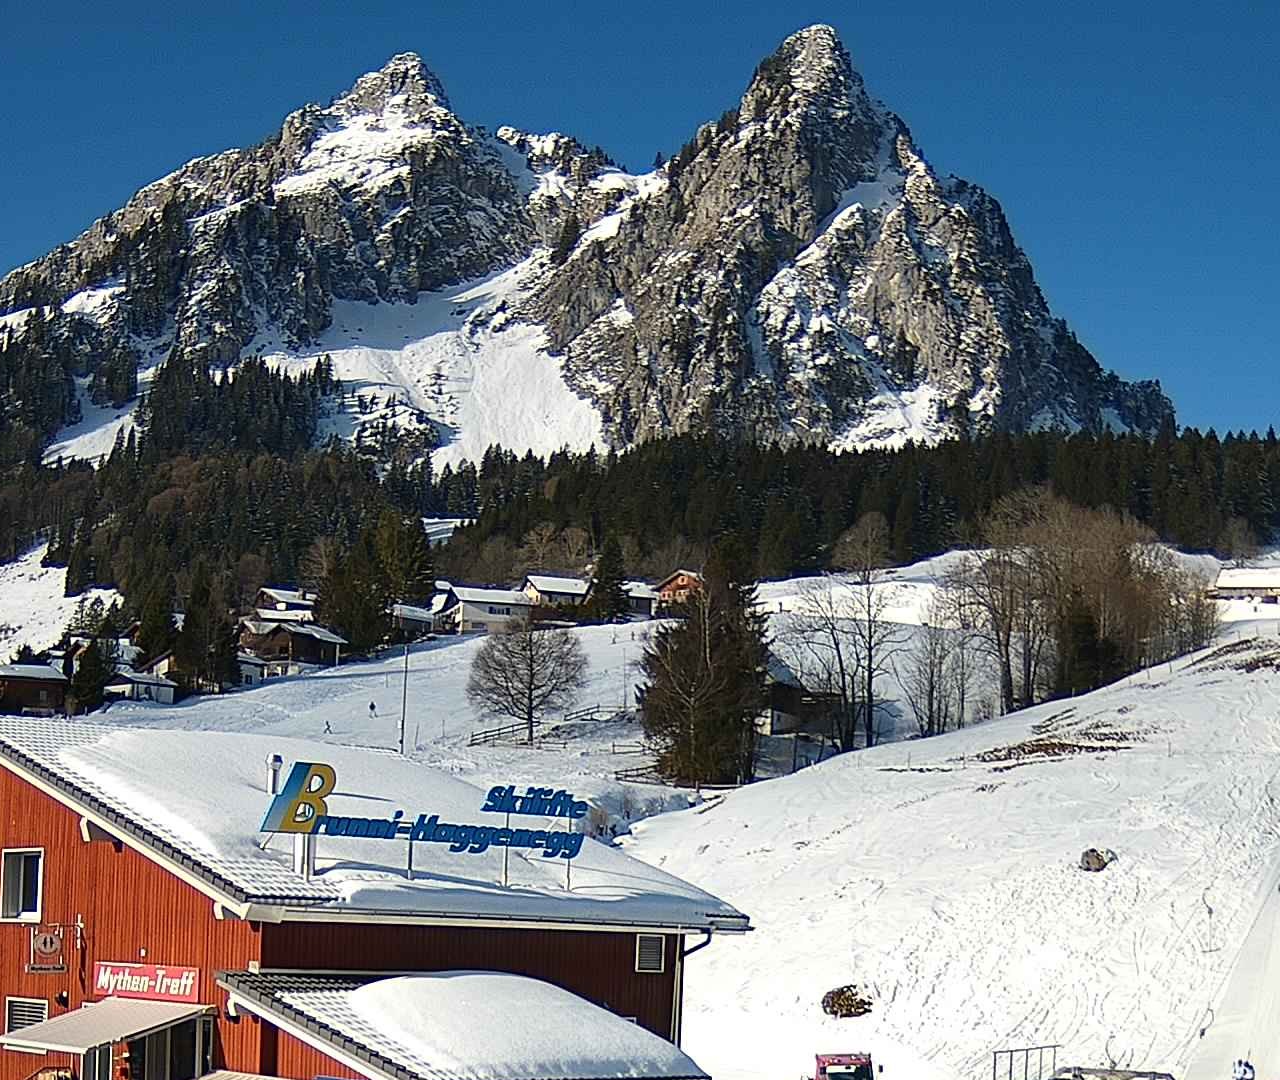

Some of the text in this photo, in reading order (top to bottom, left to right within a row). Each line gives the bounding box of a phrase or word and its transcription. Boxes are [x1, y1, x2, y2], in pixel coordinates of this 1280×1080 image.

[261, 762, 585, 858] Brunni-Haggenegg
[480, 785, 588, 819] Skilifte
[97, 966, 195, 997] Mythen-Treff
